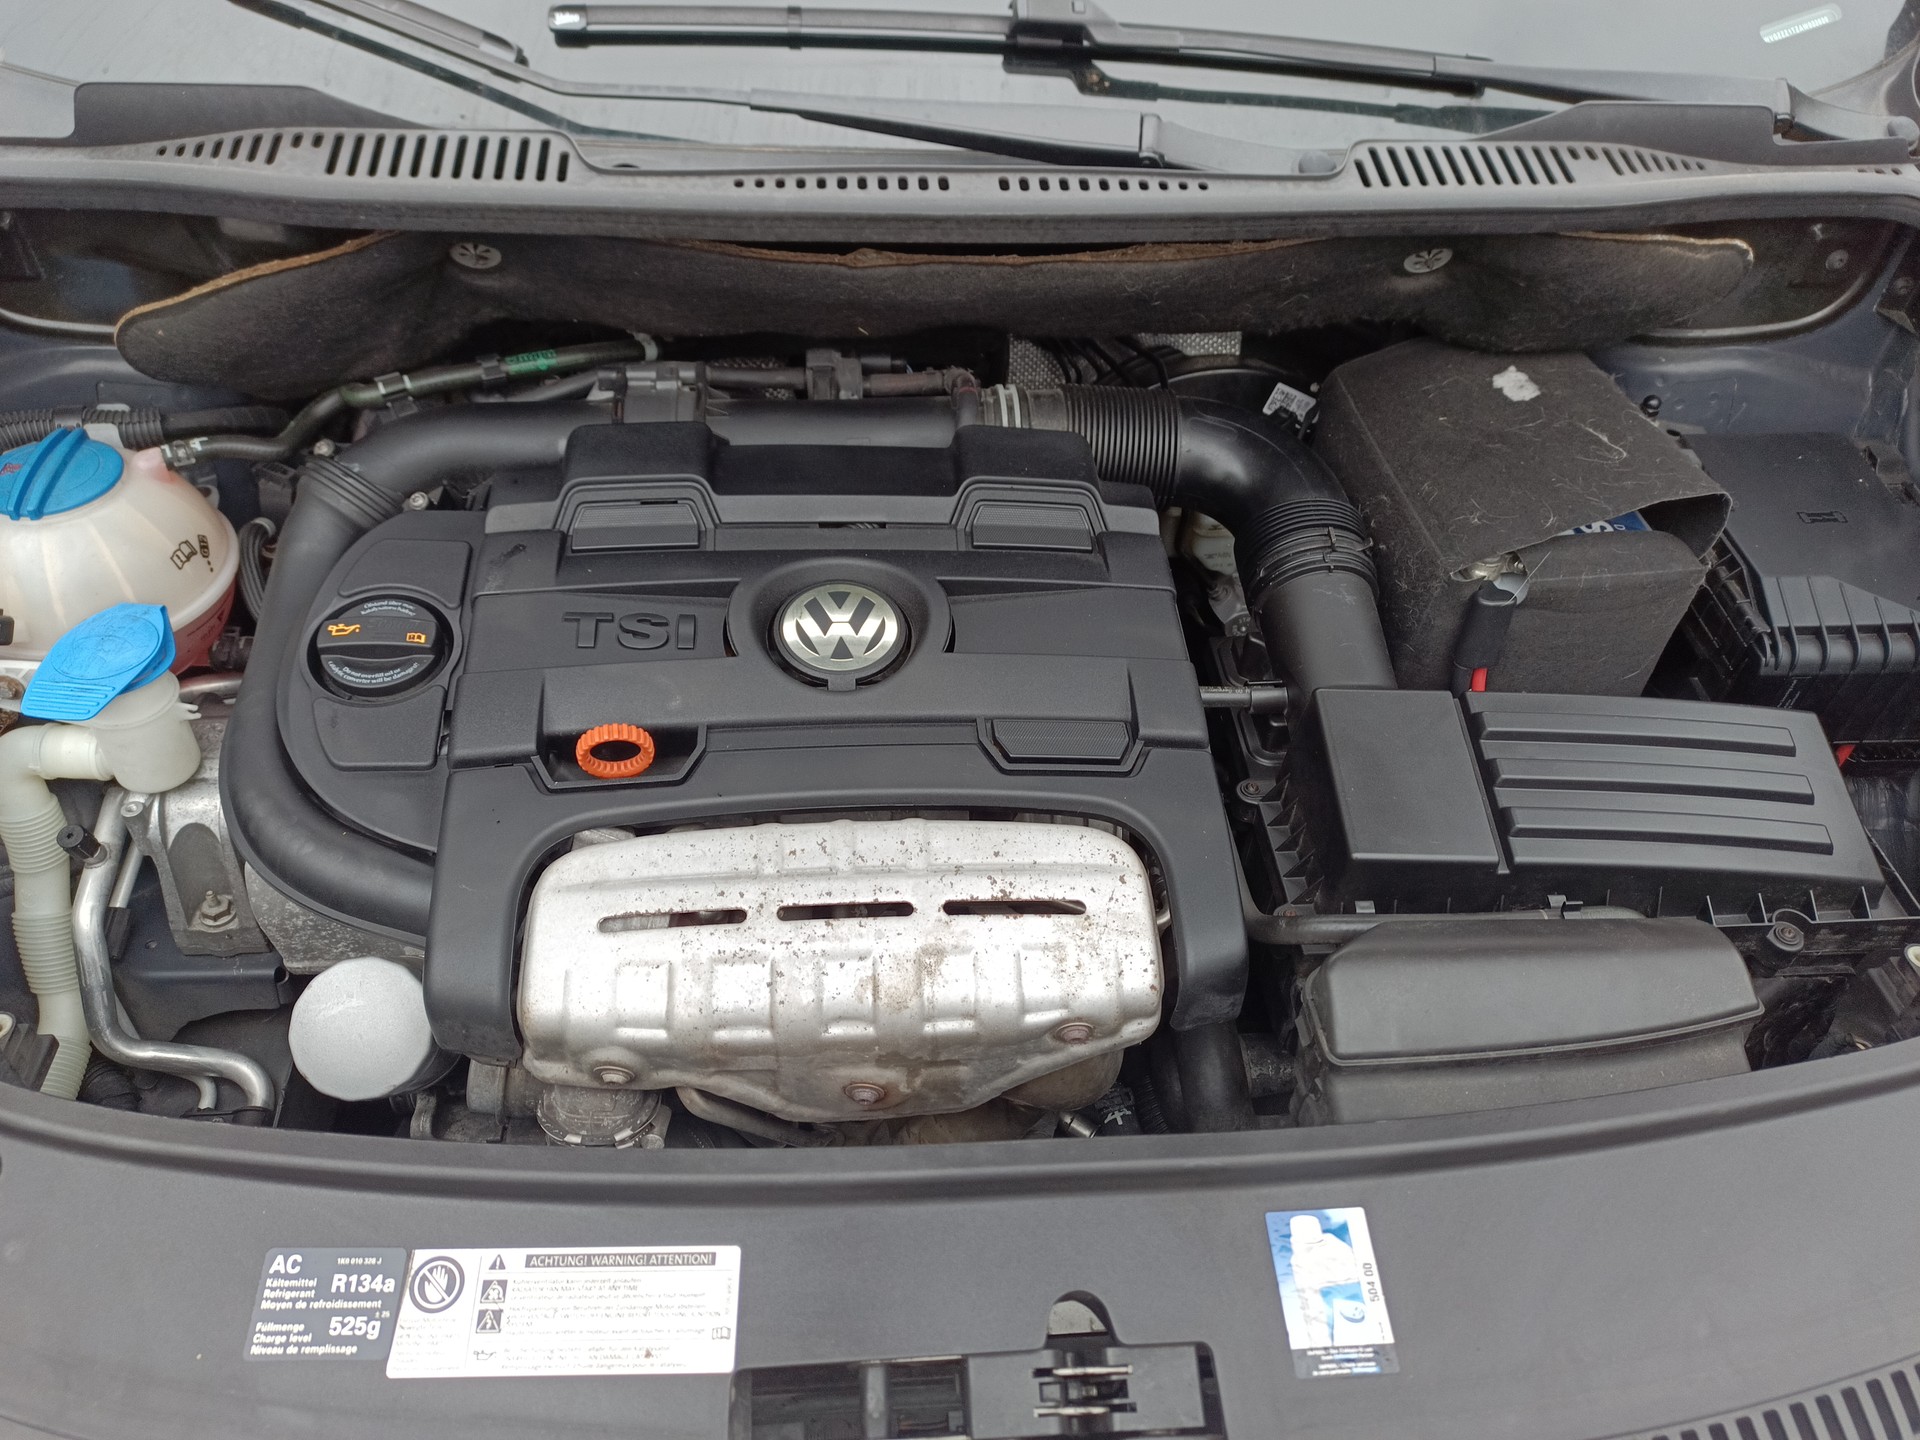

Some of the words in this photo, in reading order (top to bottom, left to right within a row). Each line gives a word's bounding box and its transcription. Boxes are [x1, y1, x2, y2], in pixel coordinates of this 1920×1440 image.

[562, 611, 697, 651] TSI
[269, 1254, 302, 1274] AC
[529, 1254, 588, 1267] ACHTUNG!
[590, 1254, 647, 1267] WARNING!
[648, 1253, 712, 1266] ATTENTION!
[1362, 1262, 1374, 1277] 00
[265, 1278, 317, 1288] Kältemittel
[331, 1273, 396, 1293] R134a
[263, 1289, 316, 1300] Refrigerant
[260, 1299, 293, 1311] Moyen
[295, 1299, 307, 1310] de
[309, 1299, 382, 1310] refroidissement
[255, 1322, 305, 1334] Füllmenge
[328, 1316, 382, 1340] 525g
[253, 1333, 287, 1345] Charge
[289, 1333, 313, 1343] level
[250, 1345, 284, 1356] Niveau
[286, 1345, 298, 1355] de
[301, 1344, 358, 1356] remplissage
